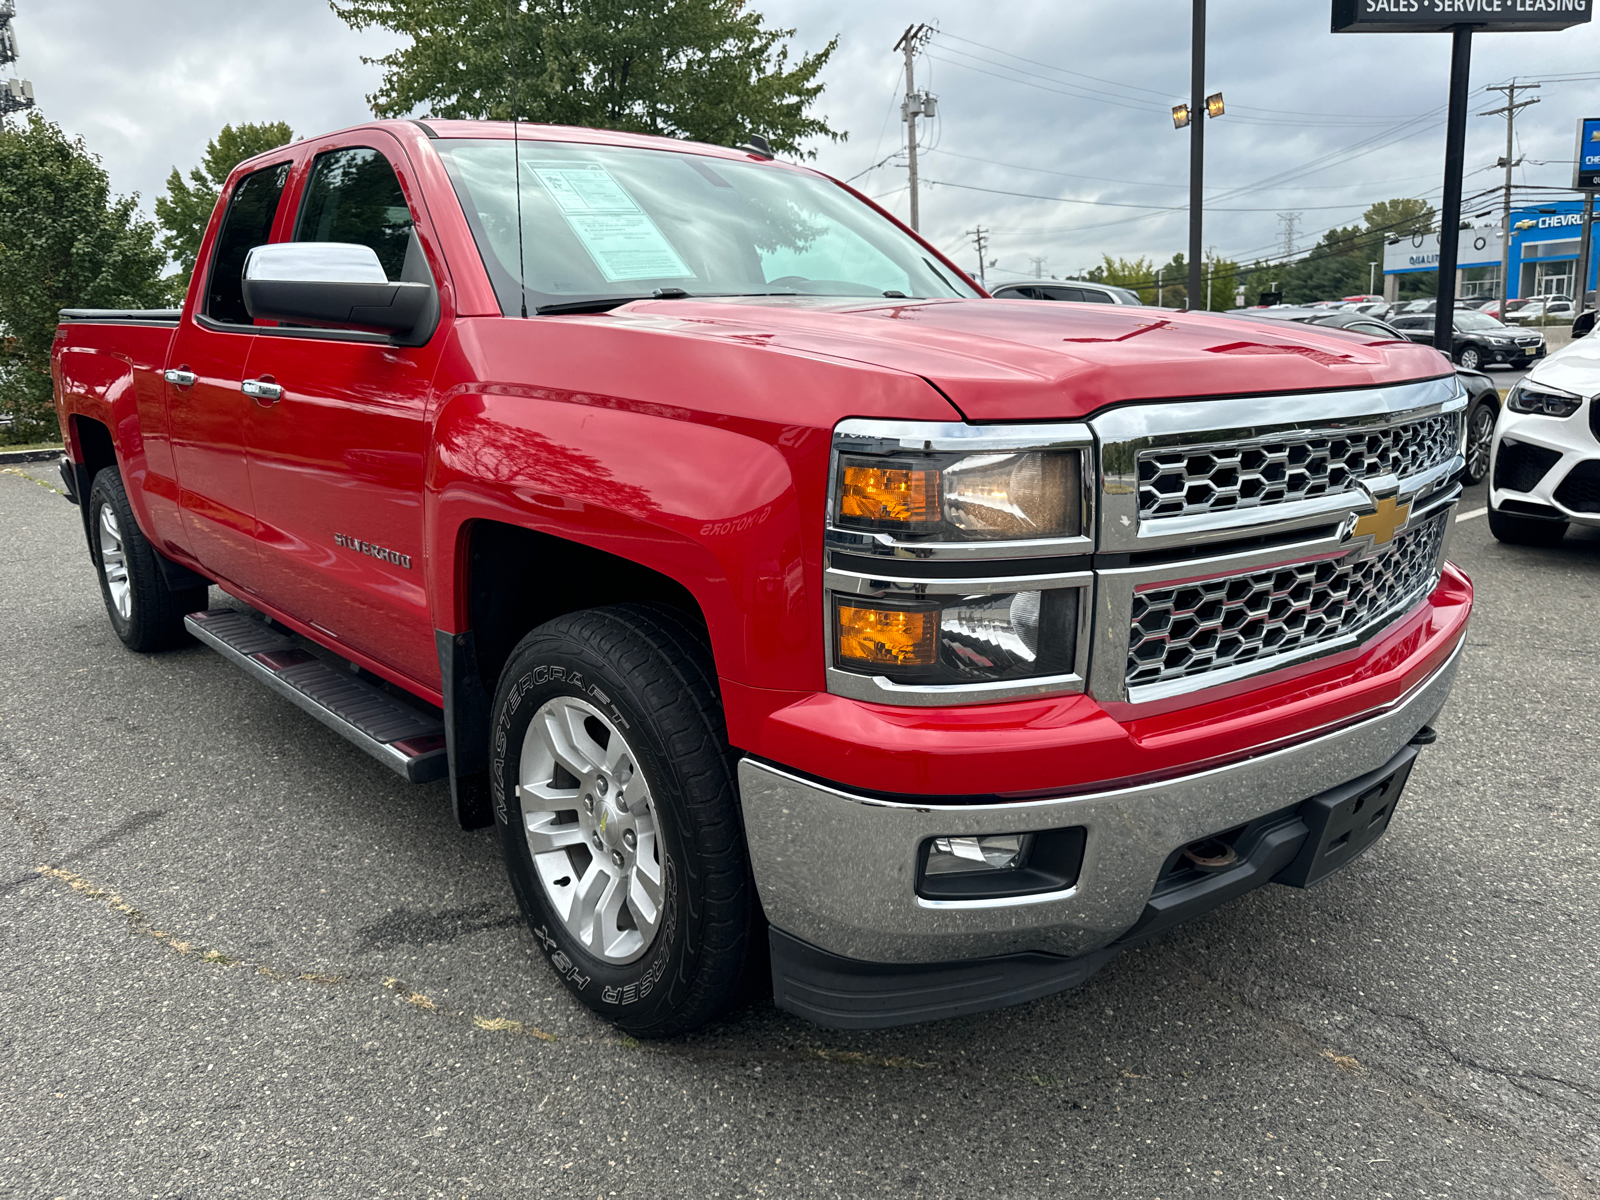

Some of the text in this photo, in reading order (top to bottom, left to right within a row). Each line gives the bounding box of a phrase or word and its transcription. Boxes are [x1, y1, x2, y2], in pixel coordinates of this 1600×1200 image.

[1366, 0, 1586, 12] SALES SERVICE LEASING
[1585, 155, 1600, 165] CHE
[1538, 213, 1583, 229] CHEVRO
[1409, 254, 1439, 266] QUALIT
[334, 532, 412, 570] SILVERADO
[494, 665, 631, 825] MASTERCRAFT
[534, 854, 678, 1006] COURSER HSX
